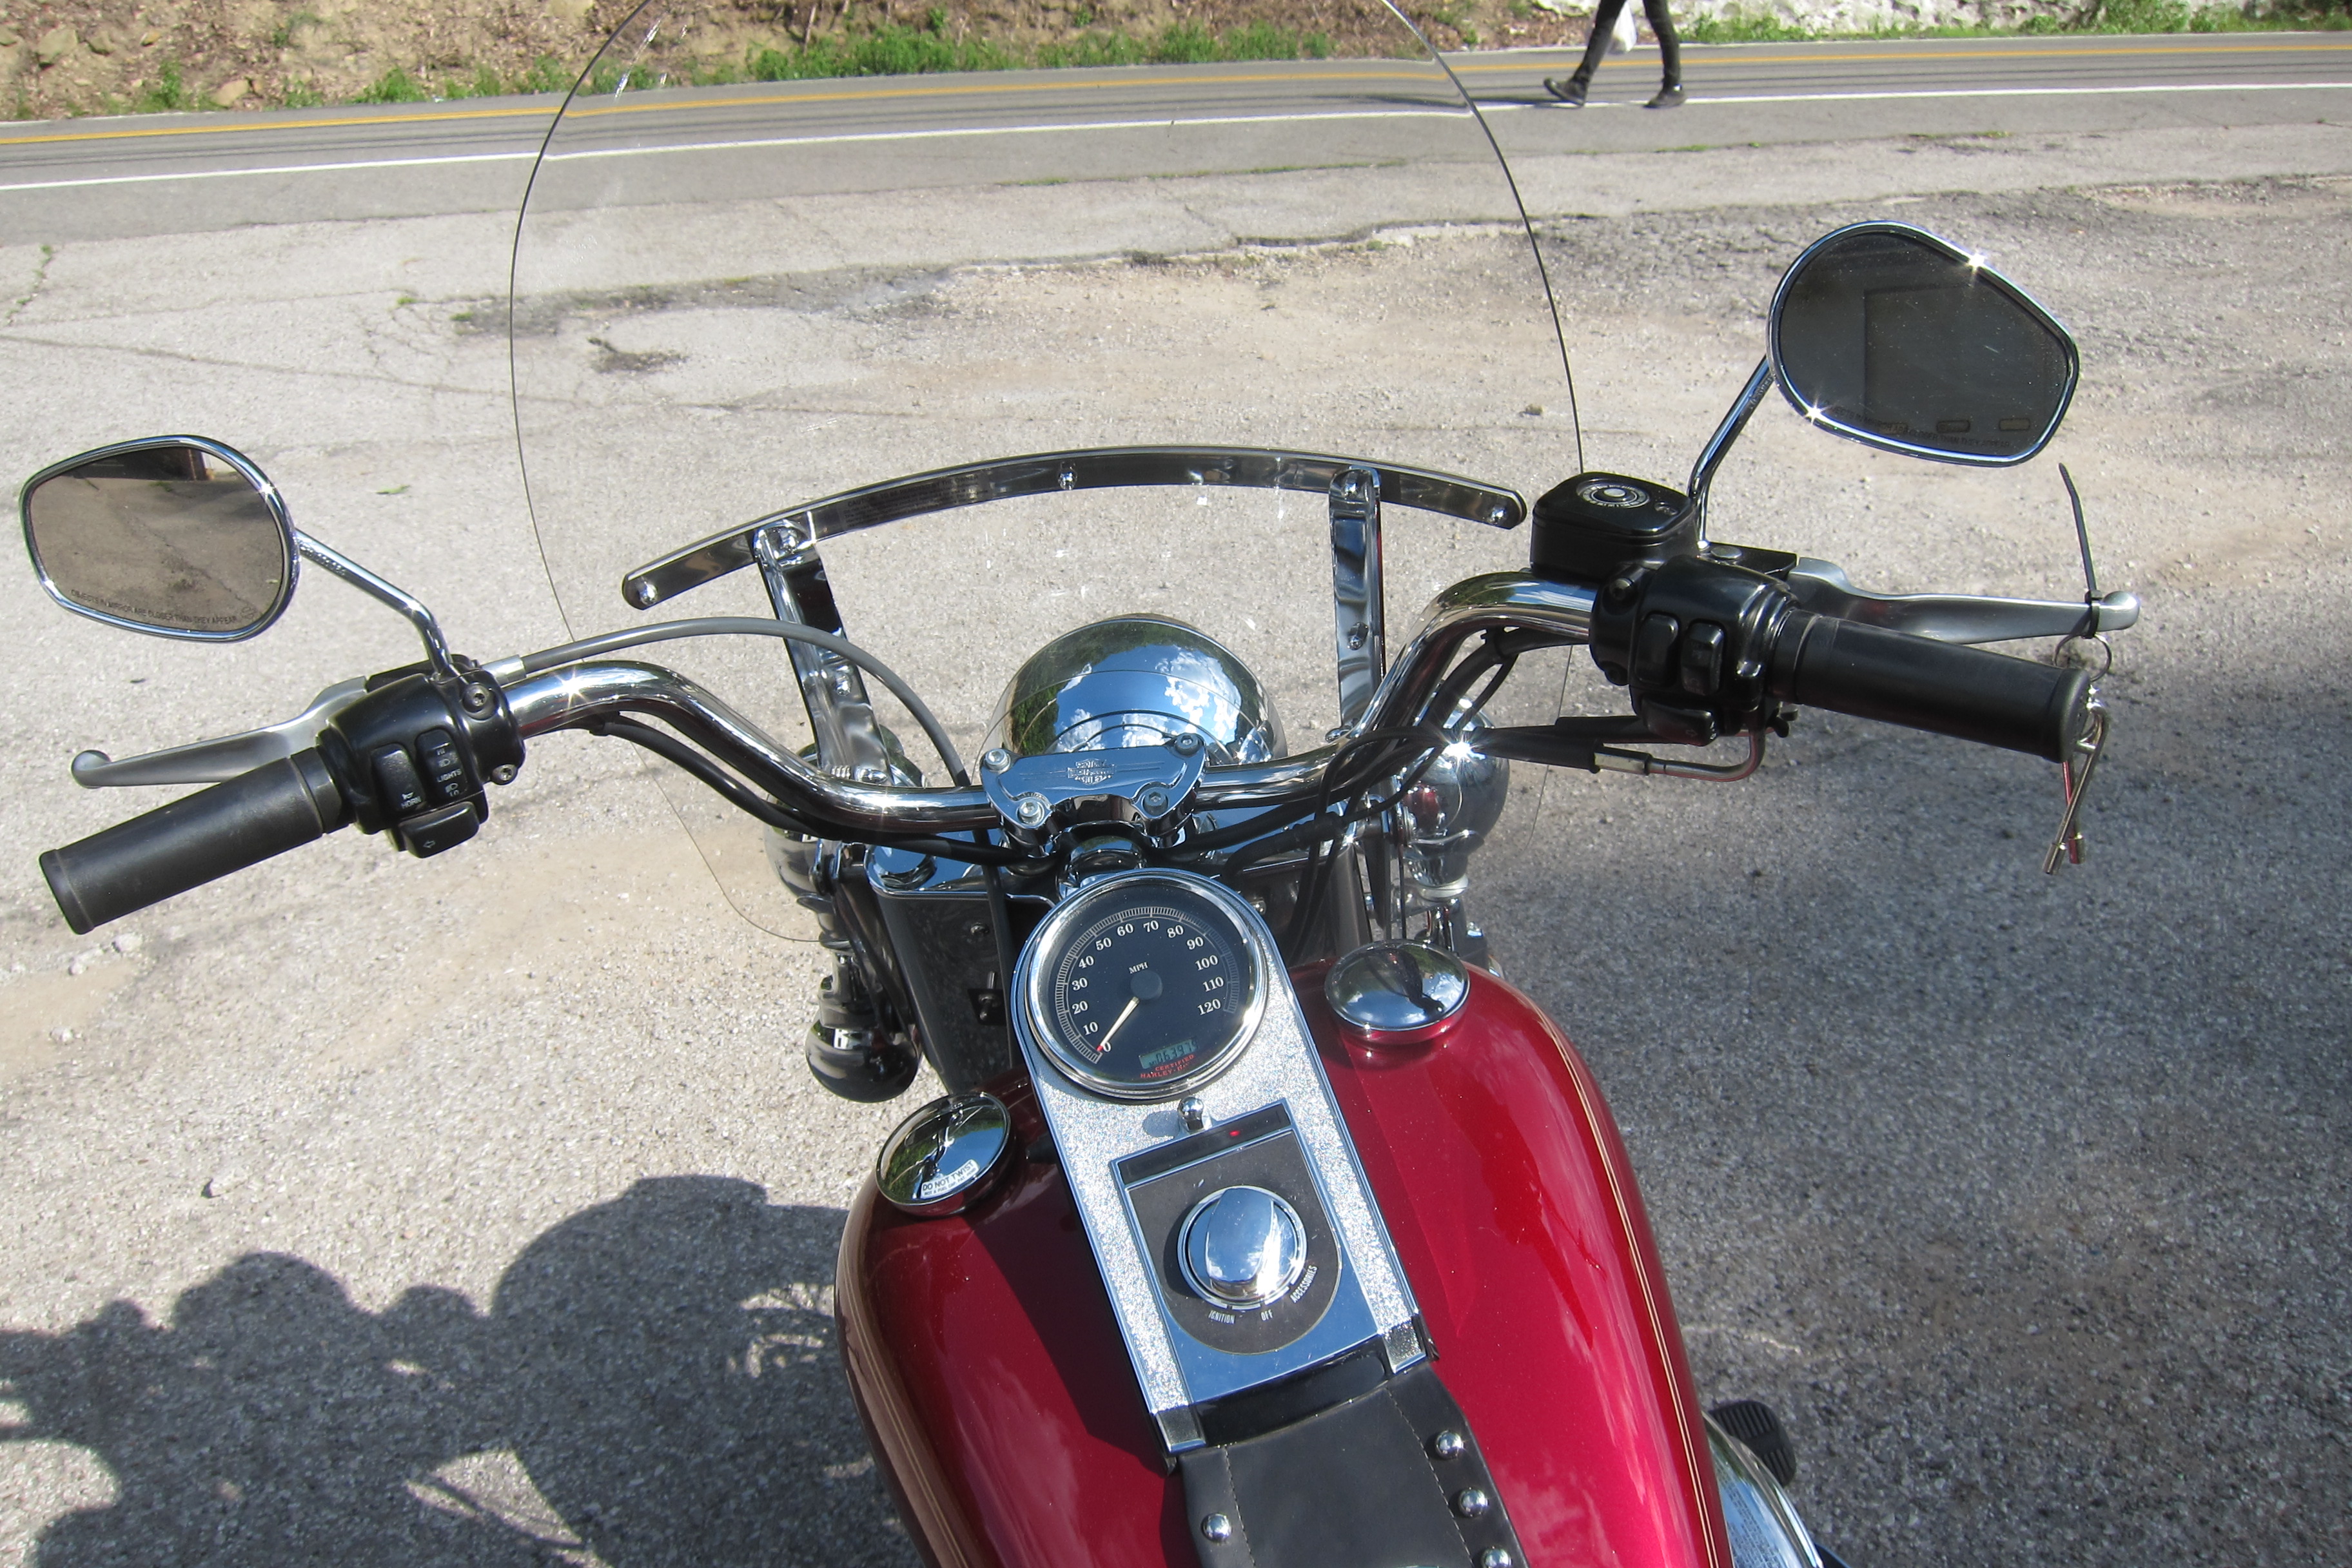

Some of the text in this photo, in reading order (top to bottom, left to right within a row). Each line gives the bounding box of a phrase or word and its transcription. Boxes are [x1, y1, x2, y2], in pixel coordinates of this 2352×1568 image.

[211, 614, 238, 624] APPEAR
[436, 769, 462, 783] LIGHTS
[401, 796, 422, 809] HORN
[1117, 923, 1134, 937] 60
[1143, 921, 1159, 932] 70
[1167, 925, 1184, 938] 80
[1095, 937, 1112, 951] 50
[1186, 936, 1204, 950] 90
[1078, 956, 1095, 969] 40
[1128, 962, 1148, 974] MPH
[1195, 955, 1219, 971] 100
[1072, 977, 1088, 991] 30
[1202, 977, 1224, 992] 110
[1072, 1001, 1088, 1015] 20
[1197, 999, 1221, 1015] 120
[1083, 1022, 1099, 1035] 10
[1102, 1042, 1112, 1053] 0
[1155, 1054, 1195, 1071] CERTIFIED
[1290, 1265, 1318, 1303] ACCESSORIES
[1208, 1309, 1235, 1324] IGNITION
[1260, 1309, 1273, 1320] OFF
